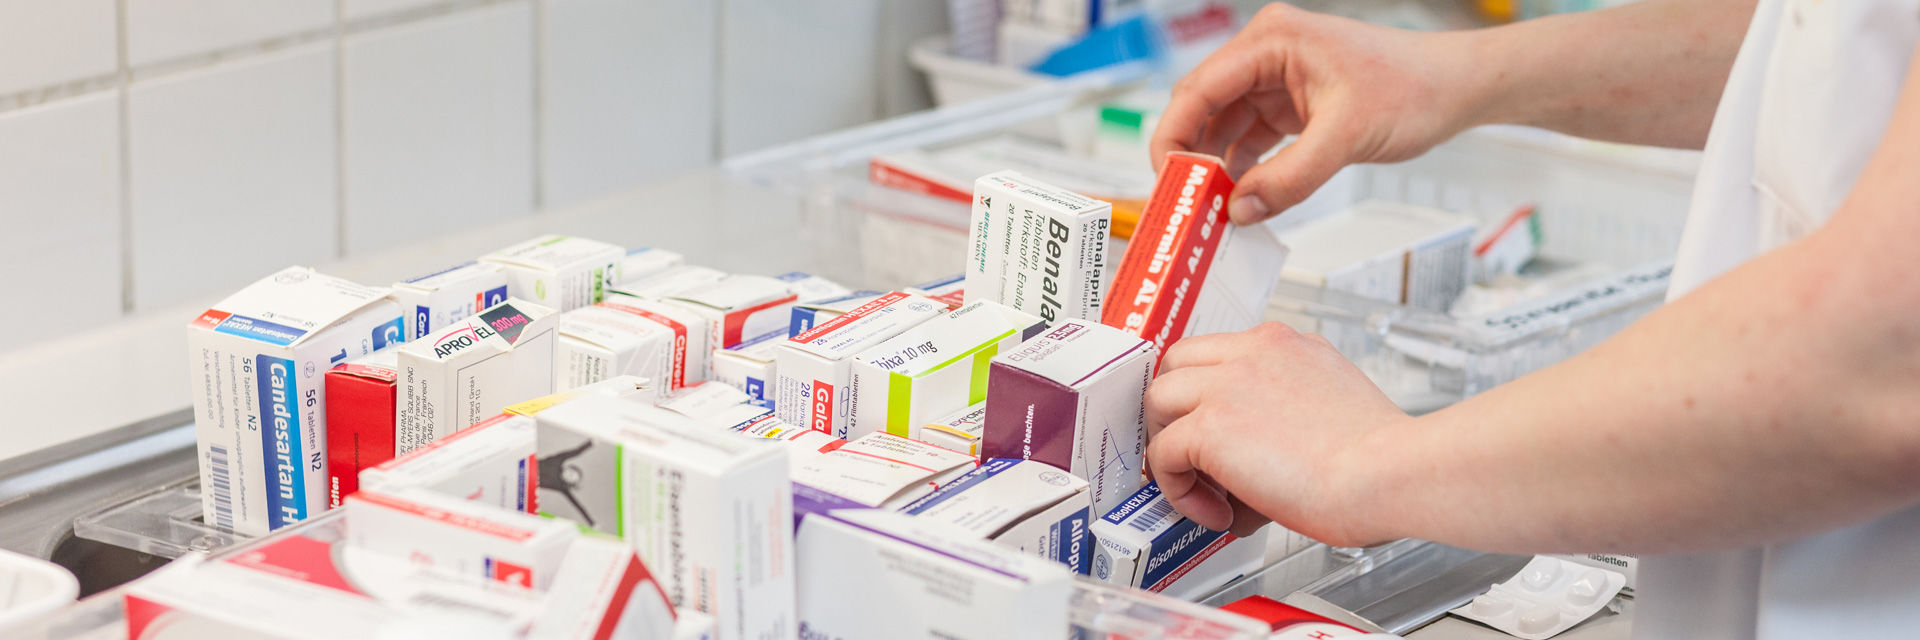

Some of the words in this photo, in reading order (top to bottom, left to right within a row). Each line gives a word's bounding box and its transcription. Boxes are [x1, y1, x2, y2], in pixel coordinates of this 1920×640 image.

[1008, 203, 1015, 214] 20
[1148, 163, 1208, 274] Metformin
[1004, 216, 1014, 255] Tabletten
[1019, 209, 1033, 269] Wirkstoff:
[1031, 213, 1045, 271] Tabletten
[1083, 224, 1088, 232] 20
[1086, 220, 1096, 267] Wirkstoff:
[1188, 246, 1204, 276] AL
[1201, 194, 1223, 240] 850
[1079, 235, 1087, 269] Tabletten
[1090, 218, 1108, 308] Benalapril
[1134, 278, 1158, 305] AL
[434, 321, 495, 359] APROVEL
[491, 316, 513, 332] 300
[510, 313, 528, 325] mg
[903, 345, 918, 360] 10
[917, 340, 938, 357] mg
[1008, 339, 1050, 362] Eliquis
[243, 357, 253, 373] 56
[244, 376, 253, 411] Tabletten
[306, 389, 317, 407] 56
[801, 382, 811, 398] 28
[850, 374, 859, 417] Filmtabletten
[247, 414, 257, 431] N2
[415, 422, 420, 431] de
[815, 388, 829, 431] Gala
[851, 418, 856, 428] 42
[1023, 403, 1035, 443] beachten.
[269, 361, 294, 499] Candesartan
[307, 411, 317, 450] Tabletten
[311, 452, 322, 472] N2
[1095, 428, 1108, 503] Filmtabletten
[1135, 442, 1141, 456] 60
[1147, 524, 1208, 575] BisoHEXAL
[1588, 553, 1628, 568] Tabletten
